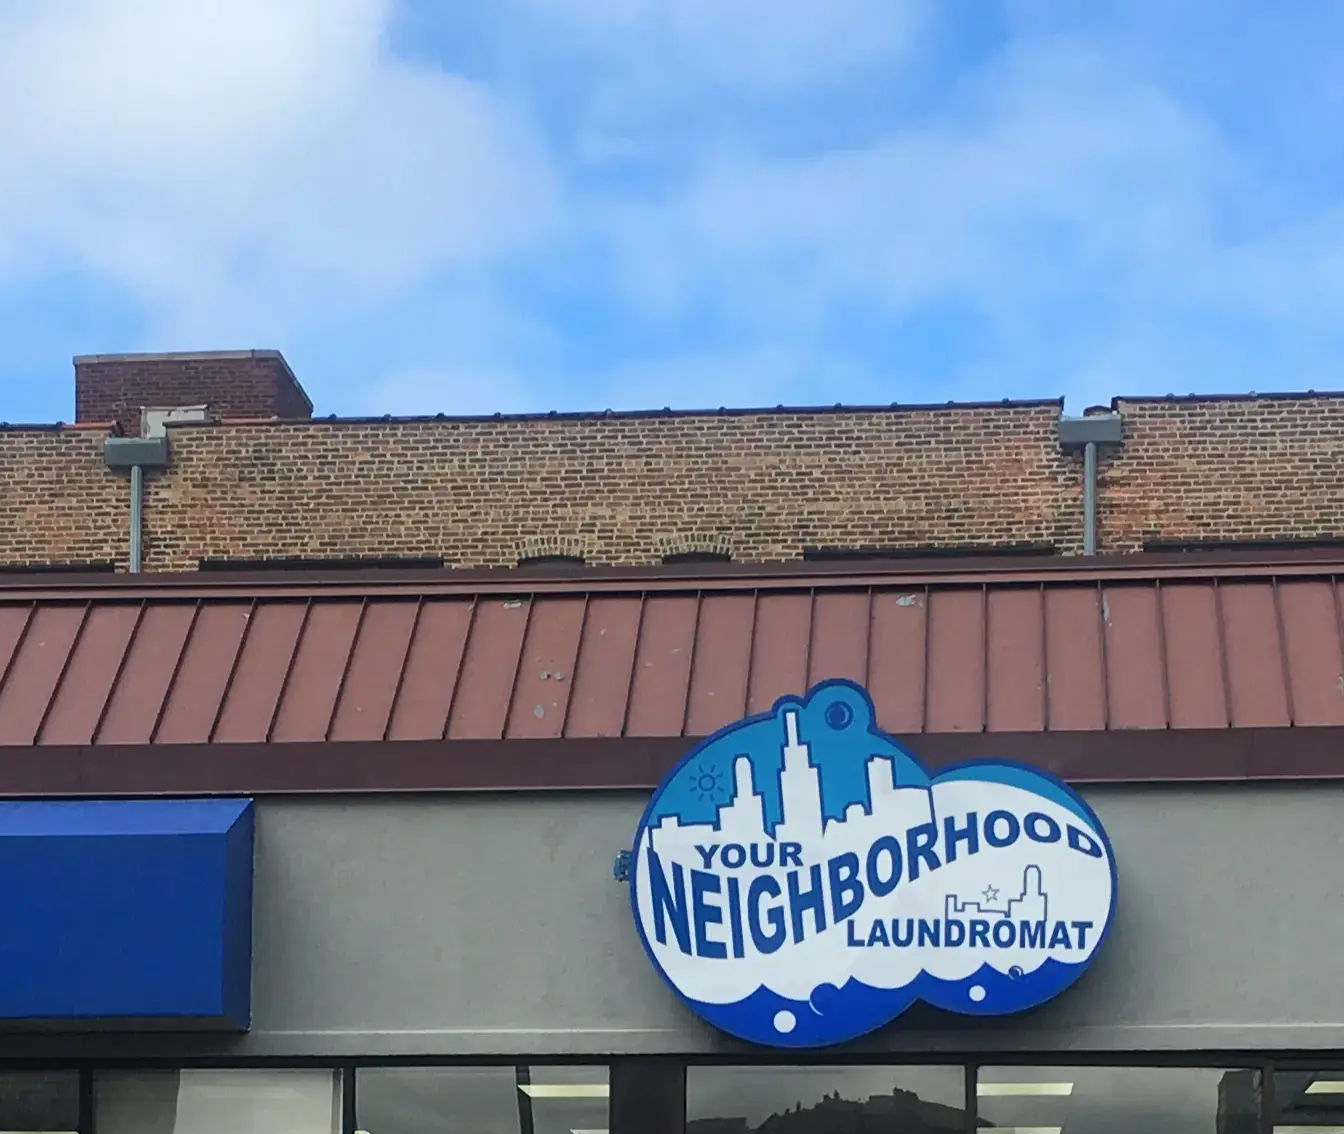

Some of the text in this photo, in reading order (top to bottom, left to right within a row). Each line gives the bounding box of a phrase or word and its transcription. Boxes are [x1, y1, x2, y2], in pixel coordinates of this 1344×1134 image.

[694, 842, 803, 869] YOUR
[647, 809, 1103, 960] NEIGHBORHOOD
[846, 918, 1093, 950] LAUNDROMAT
